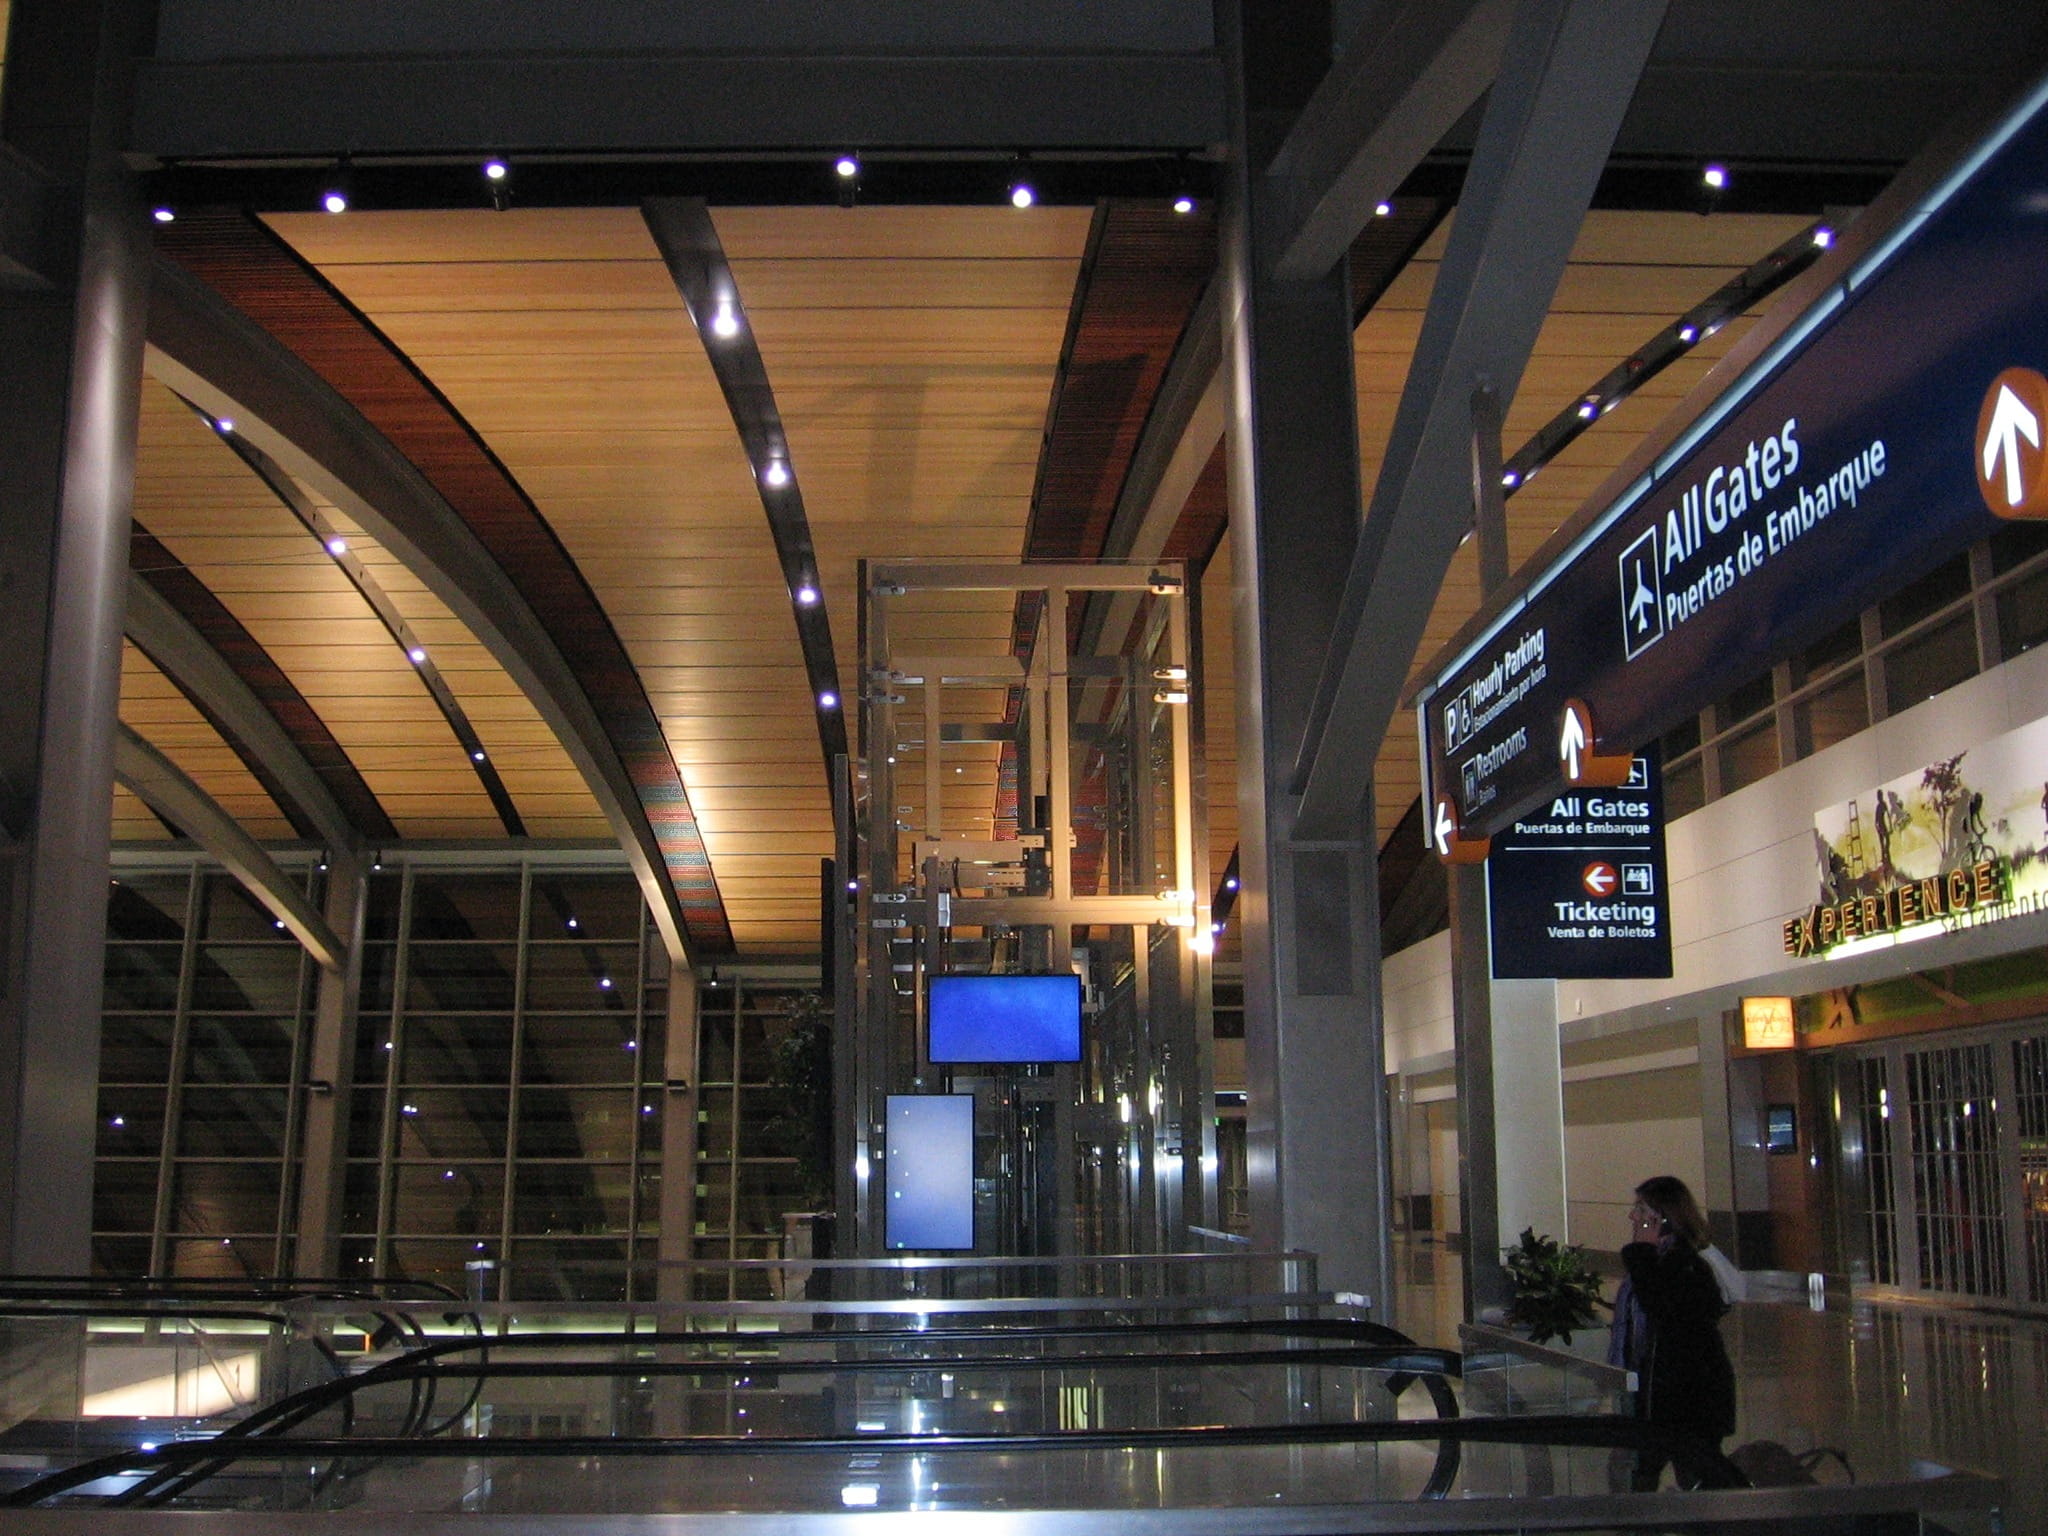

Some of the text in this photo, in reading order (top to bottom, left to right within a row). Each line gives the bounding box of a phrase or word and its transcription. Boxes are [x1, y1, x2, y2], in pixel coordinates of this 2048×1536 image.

[1664, 417, 1800, 575] All Gates
[1666, 439, 1886, 631] Puertas de Embarque
[1473, 627, 1545, 709] Hourly Parking
[1476, 726, 1527, 781] Restrooms
[1514, 821, 1650, 836] Puertas de Embarque
[1551, 797, 1650, 817] All Gates
[1547, 925, 1656, 938] Venta de Boletos
[1554, 901, 1656, 926] Ticketing
[1783, 861, 1997, 957] EXPERIENCE
